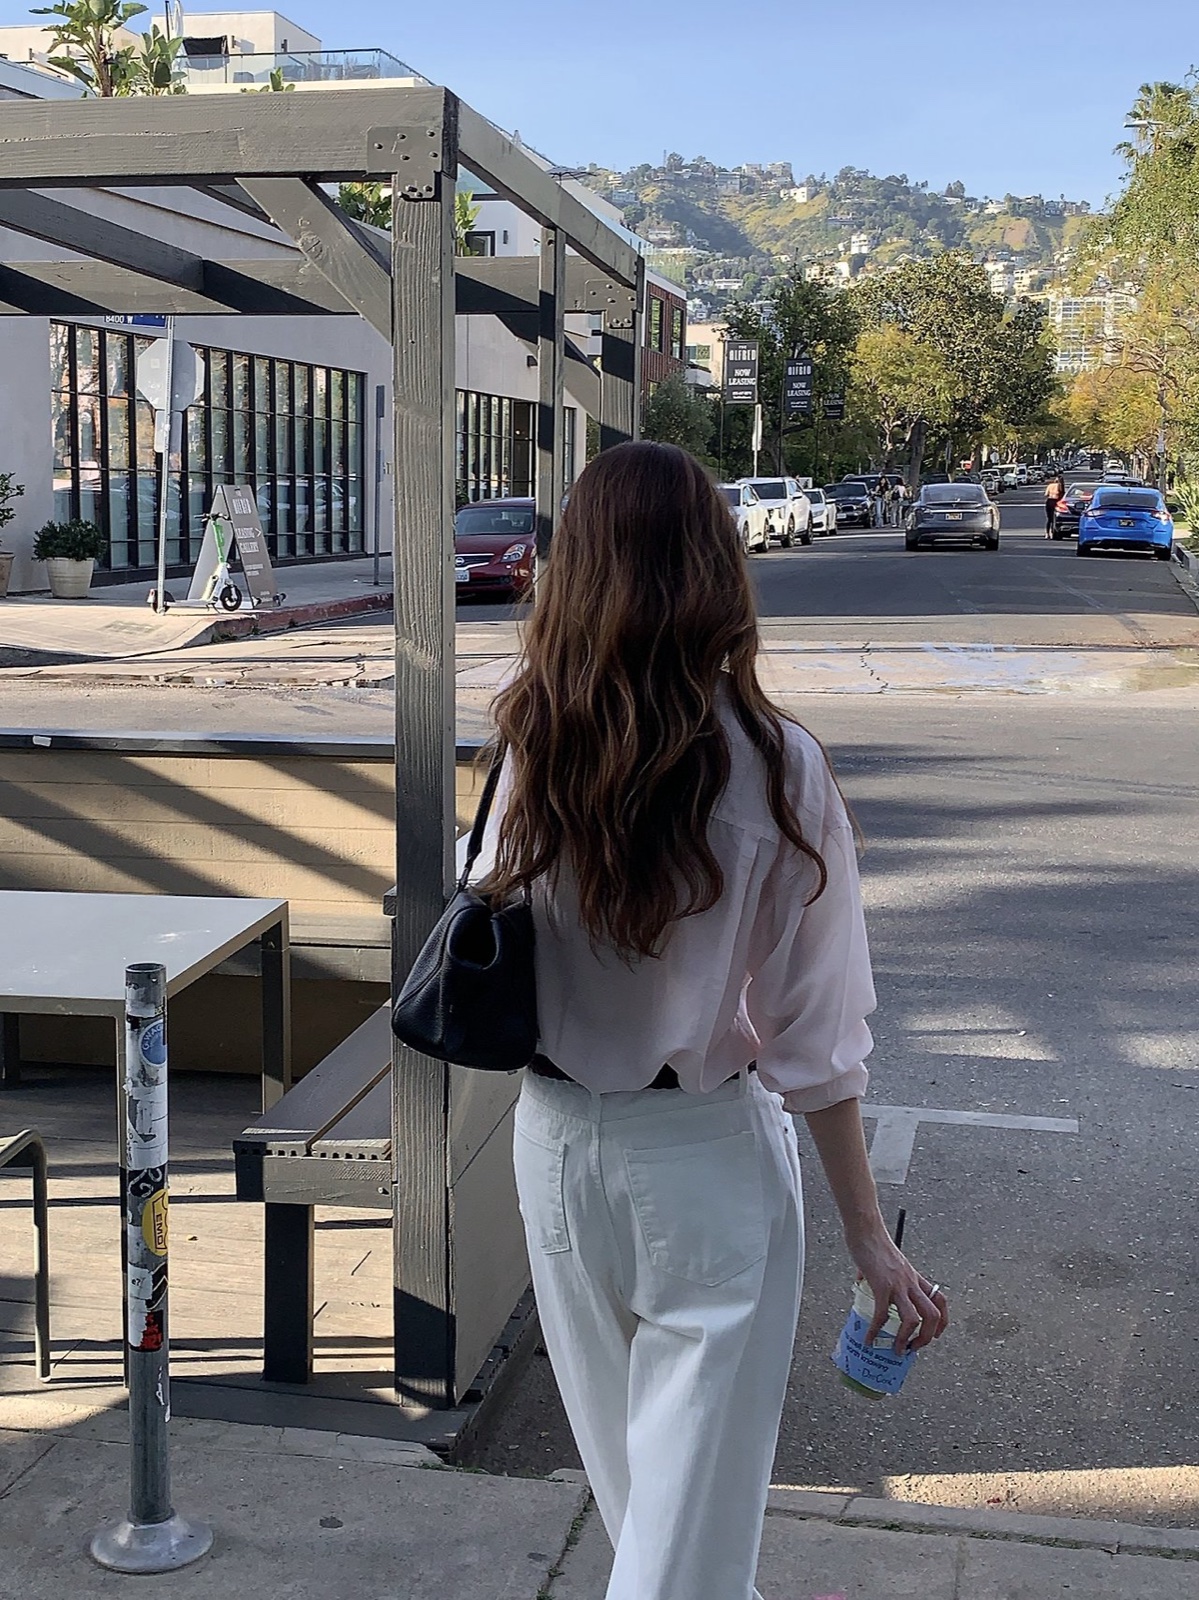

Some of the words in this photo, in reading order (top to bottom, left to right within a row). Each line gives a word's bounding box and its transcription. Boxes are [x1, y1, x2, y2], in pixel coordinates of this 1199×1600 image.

[729, 350, 756, 361] ALFRED
[734, 368, 751, 377] NOW
[728, 377, 757, 386] LEASING
